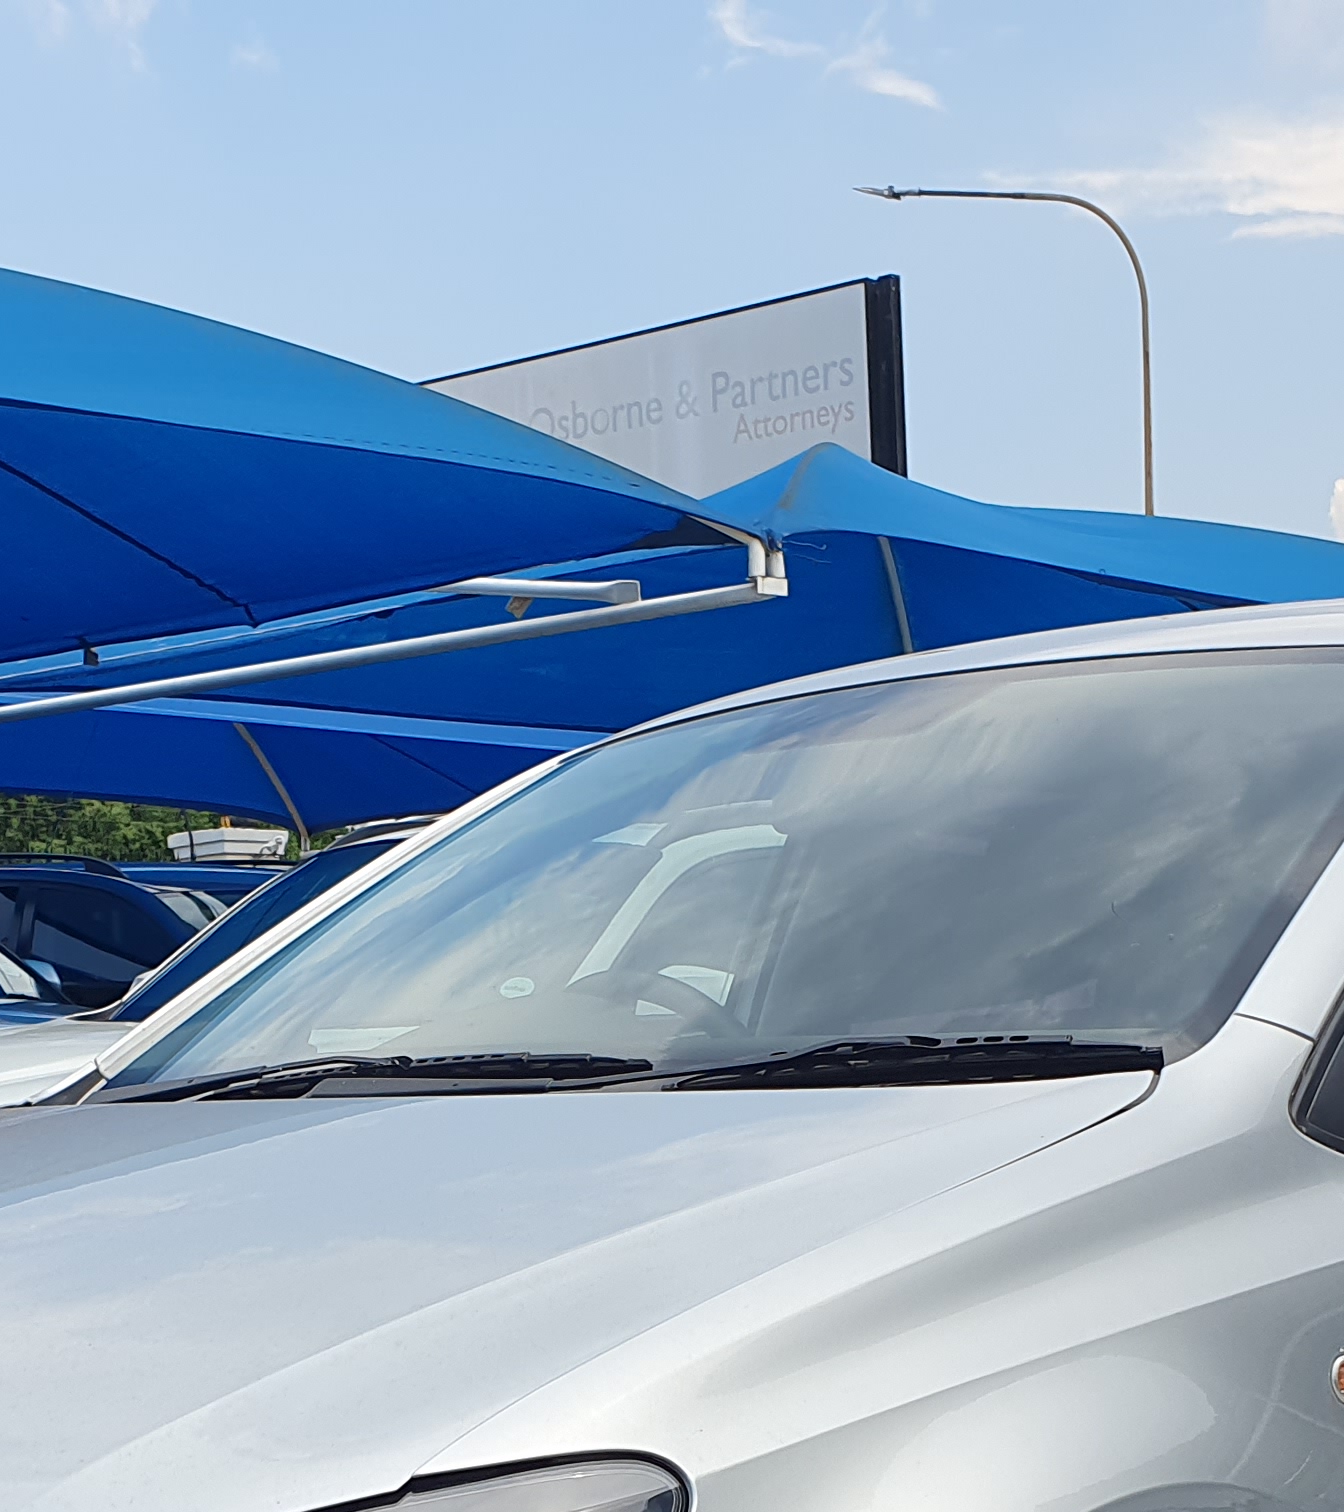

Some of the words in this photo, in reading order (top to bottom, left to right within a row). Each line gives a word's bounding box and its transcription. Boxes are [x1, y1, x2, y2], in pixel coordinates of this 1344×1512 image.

[529, 399, 663, 440] Osborne
[675, 379, 700, 419] &
[711, 357, 854, 413] Partners
[732, 400, 855, 444] Attorneys
